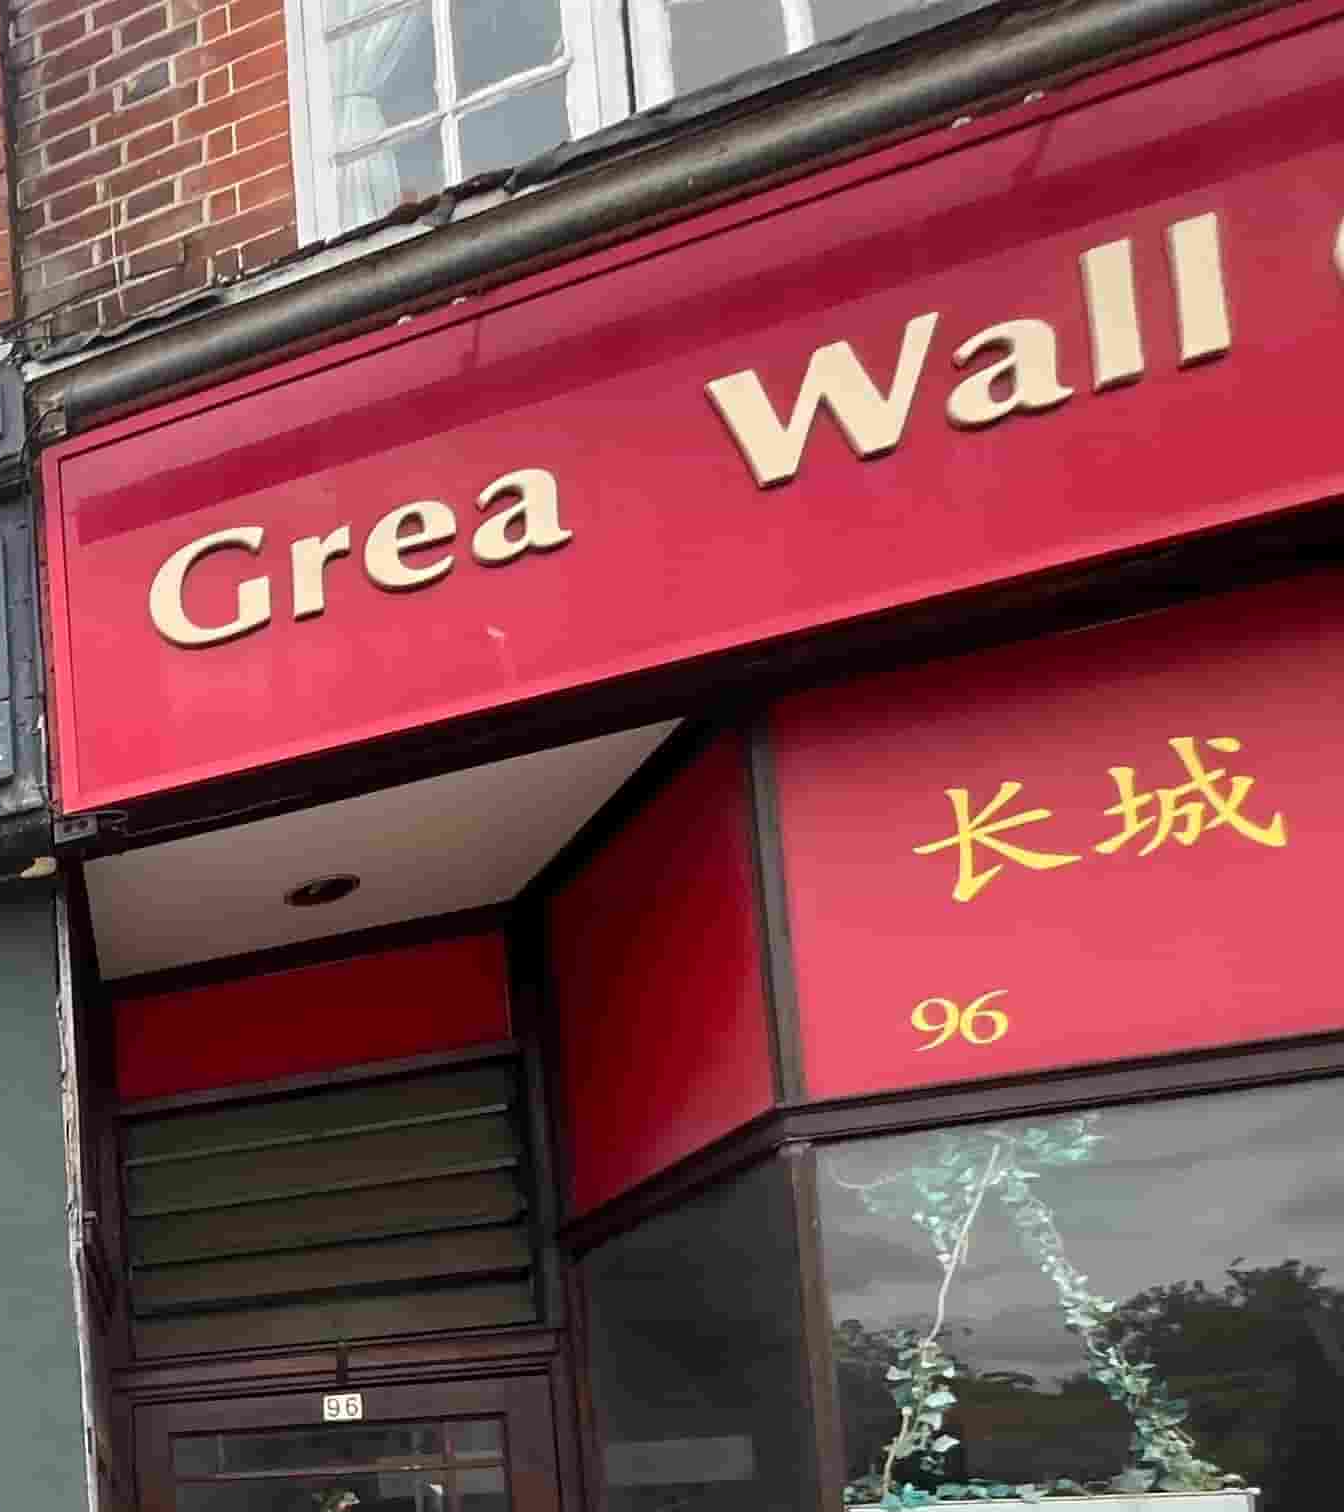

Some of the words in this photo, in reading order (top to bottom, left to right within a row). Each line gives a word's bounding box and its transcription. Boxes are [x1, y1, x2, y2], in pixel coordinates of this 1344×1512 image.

[147, 461, 572, 649] Grea
[705, 211, 1232, 489] Wall
[912, 735, 1289, 902] 长城
[911, 989, 1010, 1051] 96
[326, 1396, 359, 1418] 96
